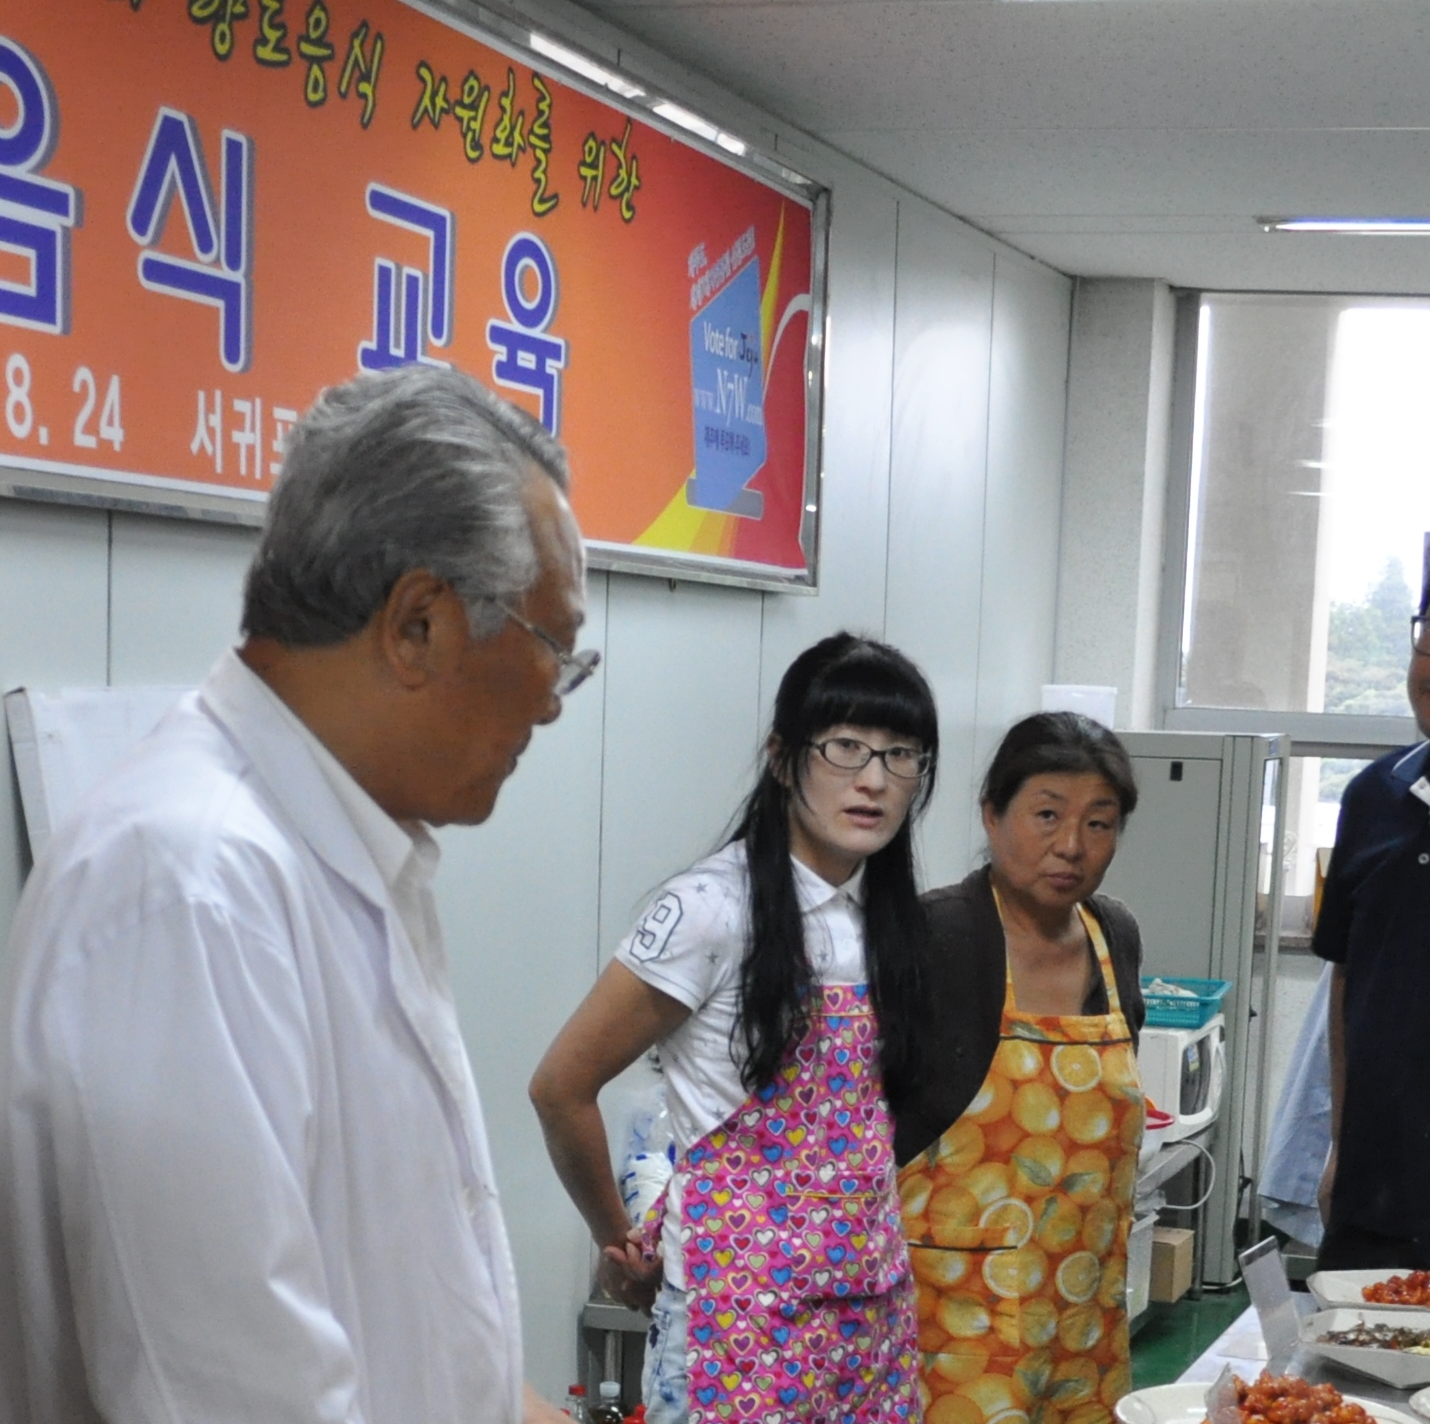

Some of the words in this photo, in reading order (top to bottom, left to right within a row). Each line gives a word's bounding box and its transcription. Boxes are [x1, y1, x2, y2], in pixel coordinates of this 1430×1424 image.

[412, 60, 559, 217] 자원화를
[578, 117, 640, 222] 위한
[358, 182, 571, 438] 교육
[703, 320, 725, 357] Vote
[725, 326, 739, 360] for
[629, 891, 683, 963] 9
